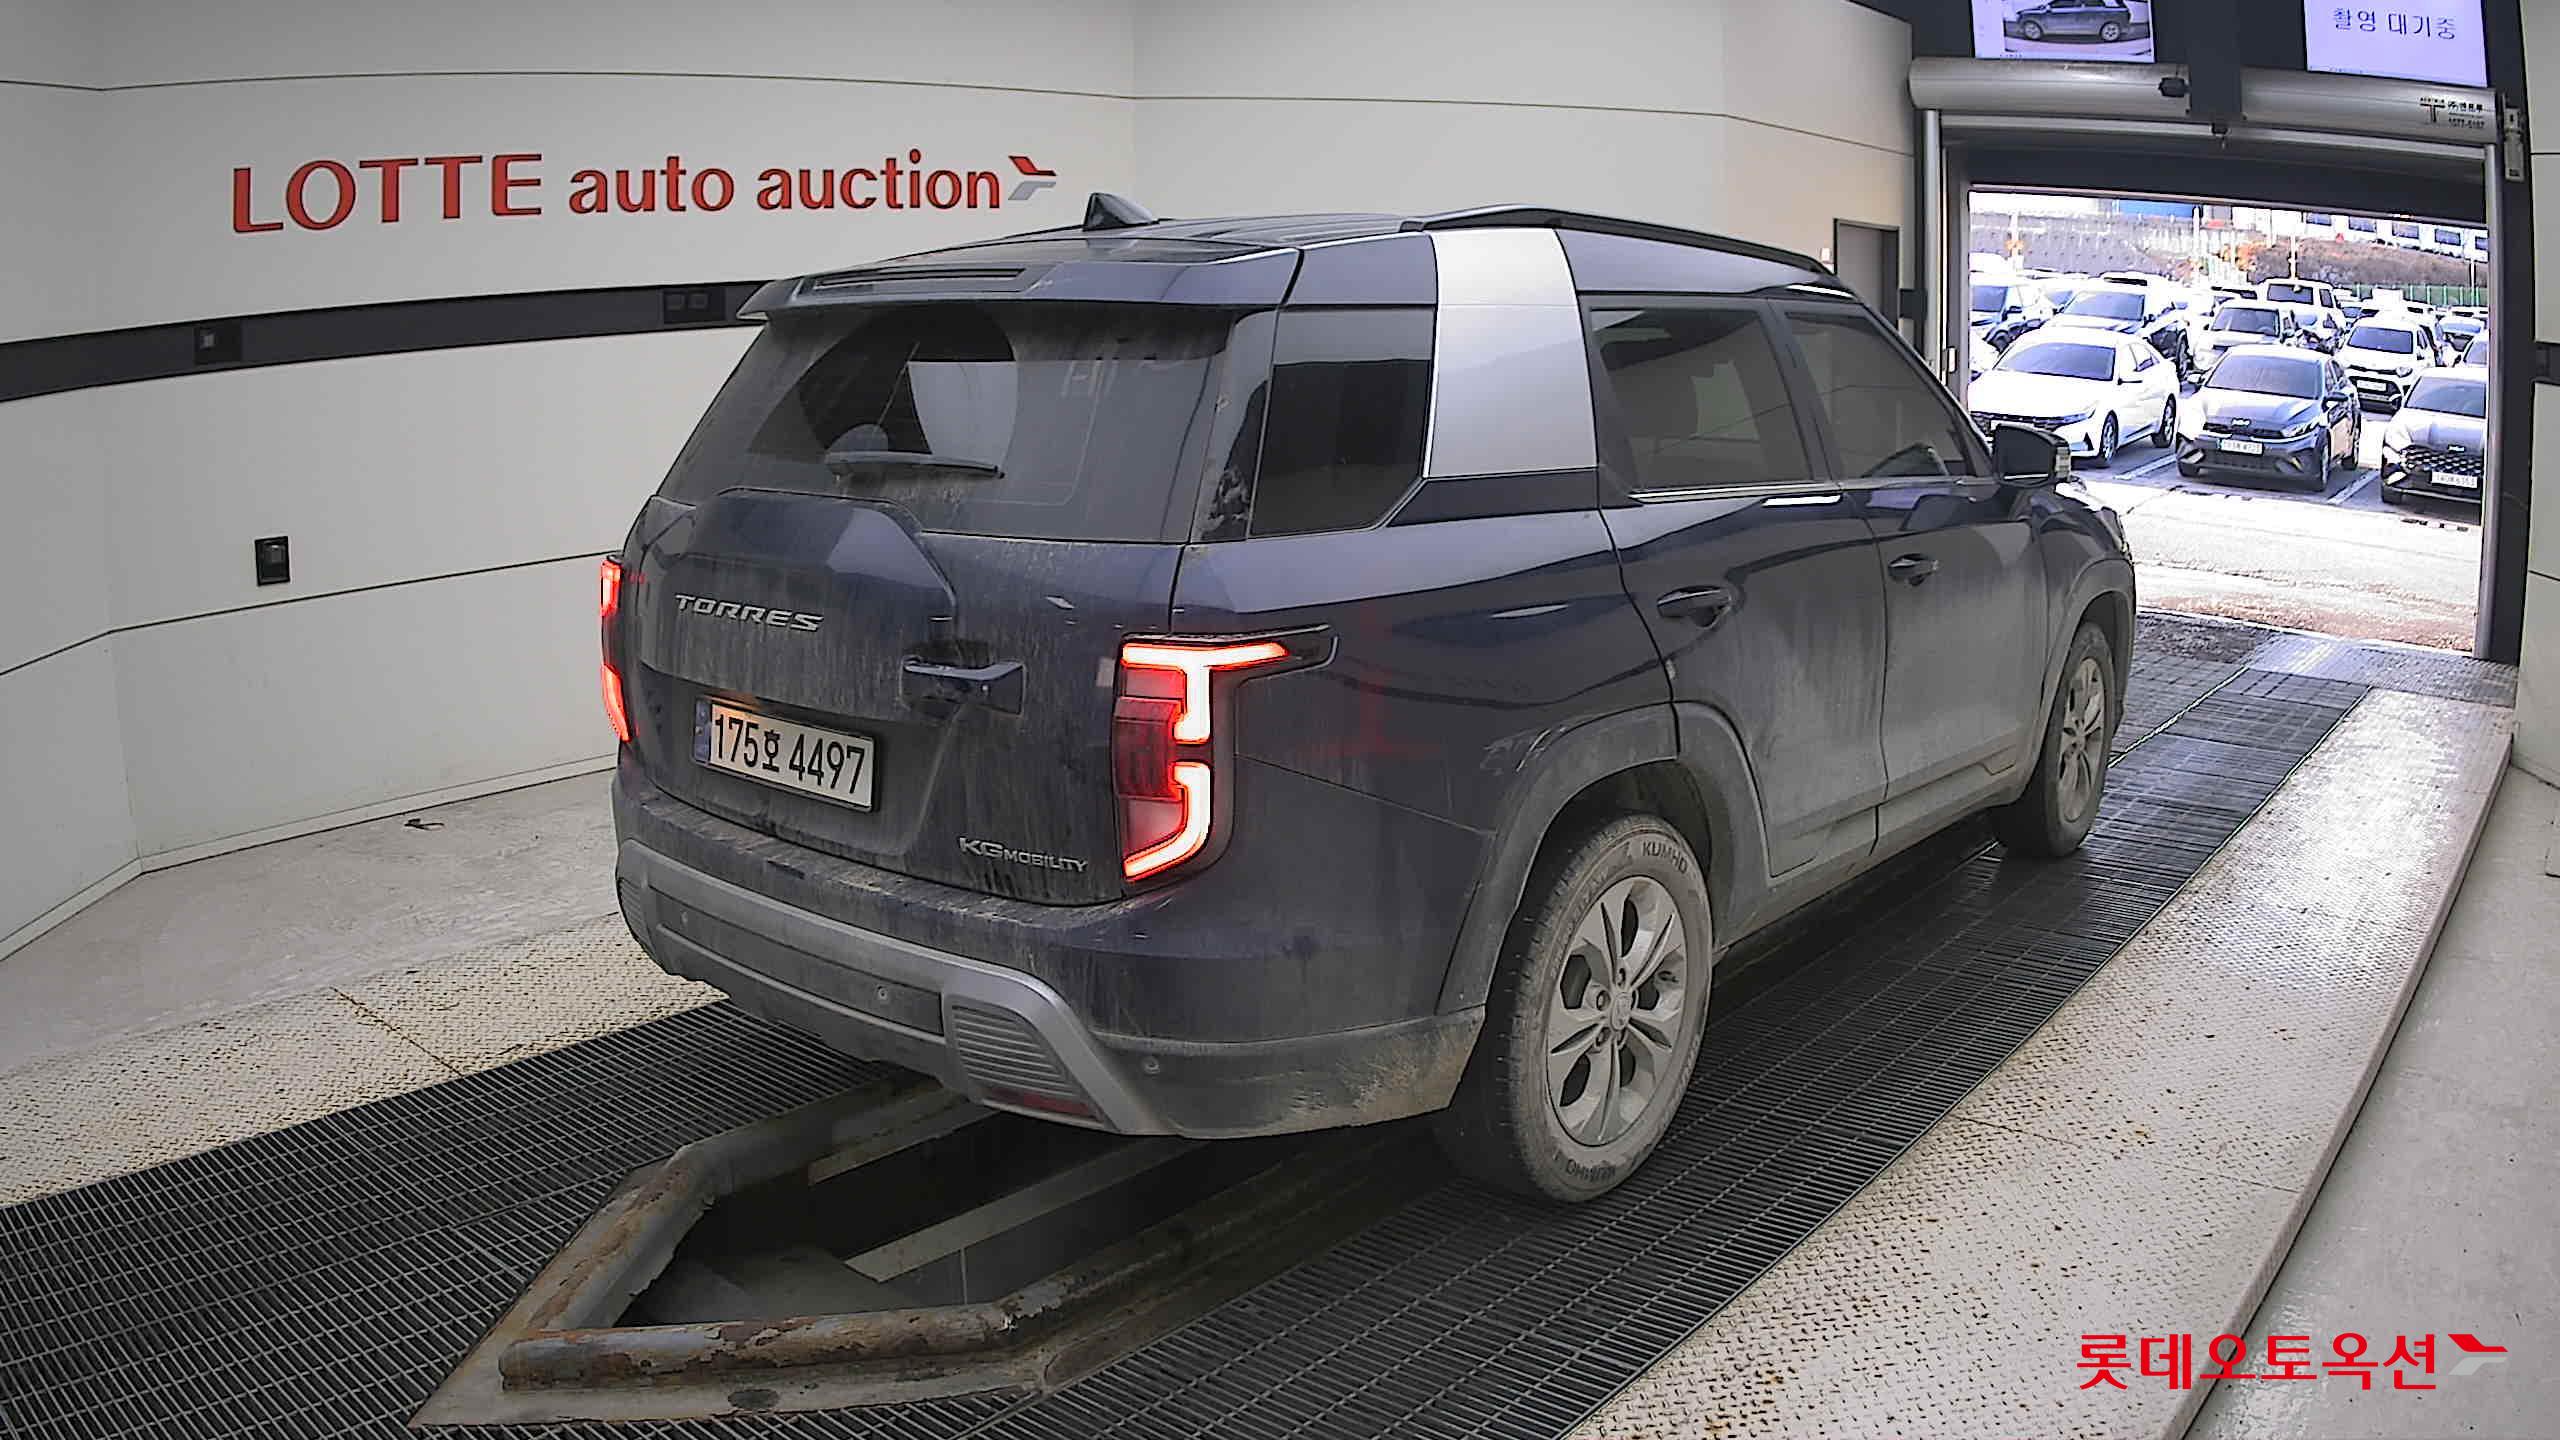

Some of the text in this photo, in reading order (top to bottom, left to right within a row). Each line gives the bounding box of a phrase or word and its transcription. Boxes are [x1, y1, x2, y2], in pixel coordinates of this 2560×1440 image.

[2333, 8, 2456, 40] 촬영 대기중
[233, 149, 1001, 234] LOTTE auto auction
[675, 594, 824, 632] TORRES
